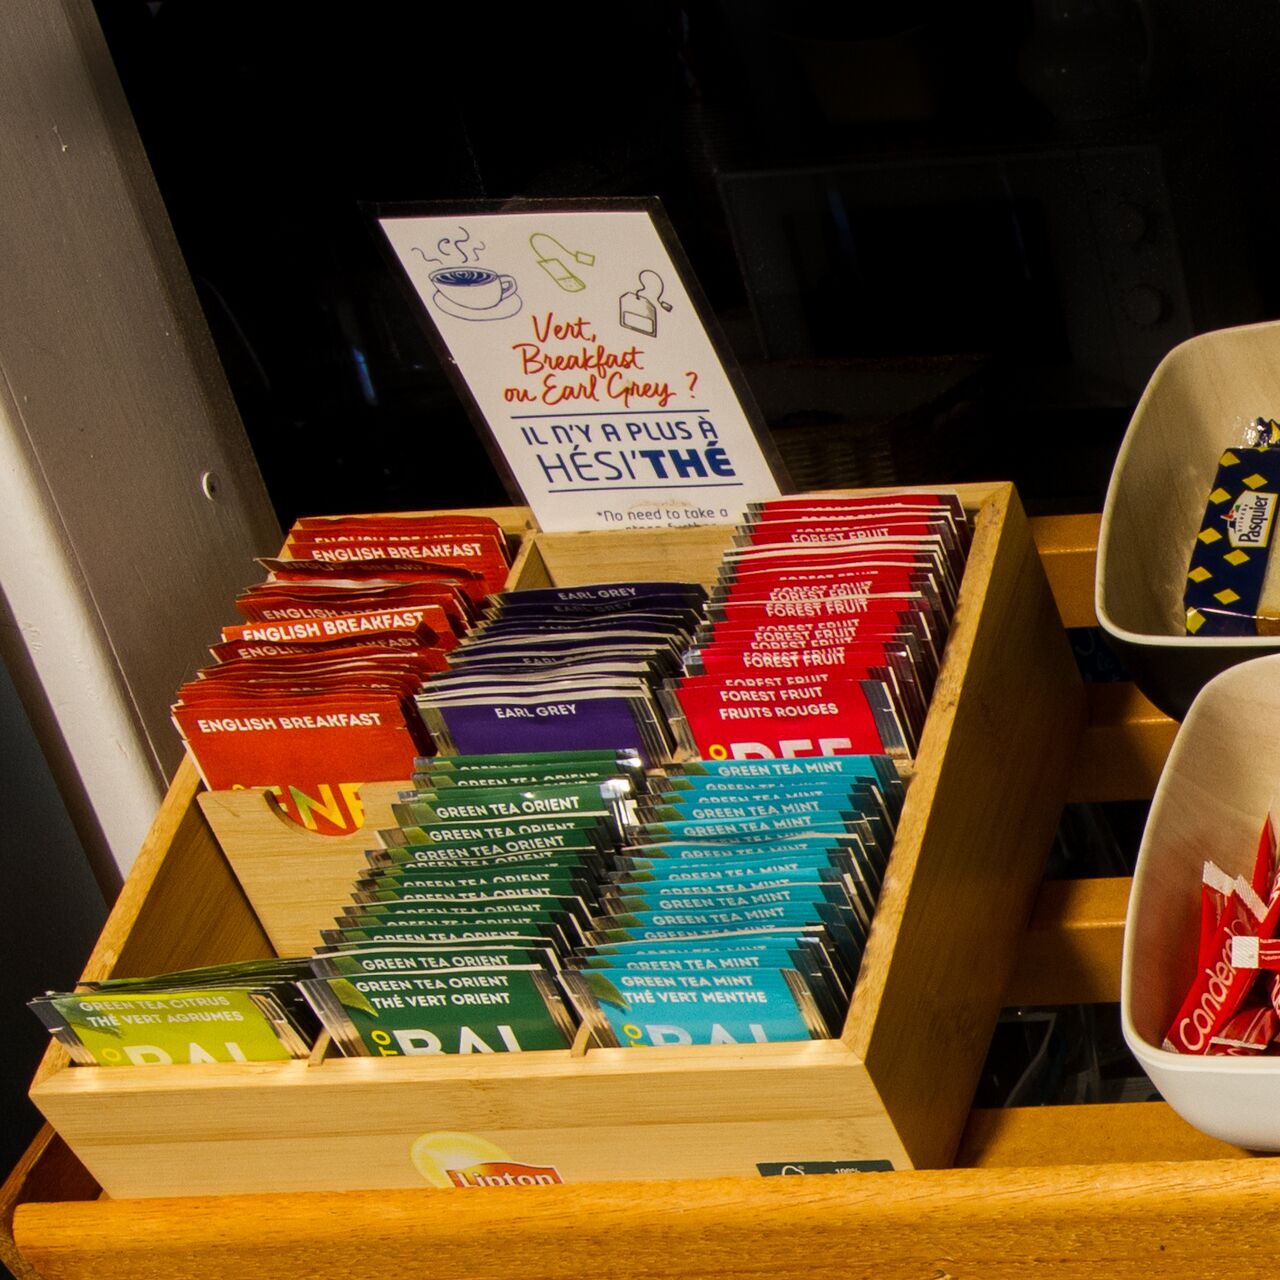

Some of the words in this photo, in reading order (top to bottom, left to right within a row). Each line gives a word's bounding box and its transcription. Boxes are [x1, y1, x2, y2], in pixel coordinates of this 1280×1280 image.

[532, 312, 596, 343] Vert,
[512, 344, 644, 378] Breakfast
[542, 374, 600, 405] Earl
[607, 371, 677, 408] Grey
[685, 372, 699, 399] ?
[520, 427, 548, 445] IL
[601, 423, 621, 442] A
[625, 420, 693, 442] PLUS
[698, 416, 719, 440] À
[536, 440, 737, 484] HÉSI'THÉ
[627, 508, 661, 520] need
[665, 508, 681, 520] to
[685, 506, 716, 519] take
[719, 508, 729, 518] a
[1238, 495, 1269, 543] Pasquier
[312, 547, 387, 562] ENGLISH
[388, 543, 482, 559] BREAKFAST
[557, 590, 596, 601] EARL
[597, 587, 636, 599] GREY
[766, 605, 823, 617] FOREST
[825, 600, 869, 614] FRUIT
[242, 624, 321, 642] ENGLISH
[324, 611, 424, 637] BREAKFAST
[755, 630, 811, 642] FOREST
[814, 627, 857, 640] FRUIT
[743, 656, 800, 668] FOREST
[803, 653, 846, 667] FRUIT
[720, 690, 777, 702] FOREST
[779, 686, 823, 700] FRUIT
[494, 706, 534, 719] EARL
[536, 703, 577, 717] GREY
[719, 706, 773, 720] FRUITS
[775, 703, 839, 717] ROUGES
[197, 717, 277, 733] ENGLISH
[280, 713, 381, 730] BREAKFAST
[718, 765, 771, 777] GREEN
[771, 763, 804, 775] TEA
[804, 761, 843, 773] MINT
[436, 805, 488, 819] GREEN
[489, 802, 520, 815] TEA
[521, 796, 580, 813] ORIENT
[692, 807, 746, 819] GREEN
[747, 805, 780, 817] TEA
[782, 801, 821, 814] MINT
[429, 829, 483, 842] GREEN
[484, 827, 516, 838] TEA
[683, 823, 738, 837] GREEN
[739, 823, 771, 833] TEA
[772, 816, 812, 829] MINT
[414, 847, 469, 862] GREEN
[470, 844, 503, 857] TEA
[505, 836, 564, 852] ORIENT
[659, 898, 715, 910] GREEN
[716, 896, 749, 907] TEA
[751, 890, 791, 903] MINT
[652, 914, 708, 926] GREEN
[709, 912, 743, 924] TEA
[744, 907, 785, 919] MINT
[362, 957, 417, 971] GREEN
[418, 956, 450, 969] TEA
[452, 955, 511, 967] ORIENT
[626, 960, 681, 970] GREEN
[683, 959, 717, 969] TEA
[718, 956, 759, 968] MINT
[356, 980, 413, 993] GREEN
[413, 979, 447, 990] TEA
[449, 976, 511, 988] ORIENT
[621, 975, 677, 987] GREEN
[678, 975, 711, 987] TEA
[713, 975, 753, 987] MINT
[79, 1000, 136, 1011] GREEN
[136, 999, 167, 1010] TEA
[168, 996, 231, 1008] CITRUS
[370, 994, 405, 1009] THÉ
[405, 995, 448, 1007] VERT
[450, 992, 511, 1006] ORIENT
[622, 989, 656, 1004] THÉ
[656, 992, 698, 1003] VERT
[702, 992, 767, 1003] MENTHE
[86, 1013, 122, 1027] THÉ
[122, 1013, 163, 1026] VERT
[167, 1010, 244, 1023] AGRUMES
